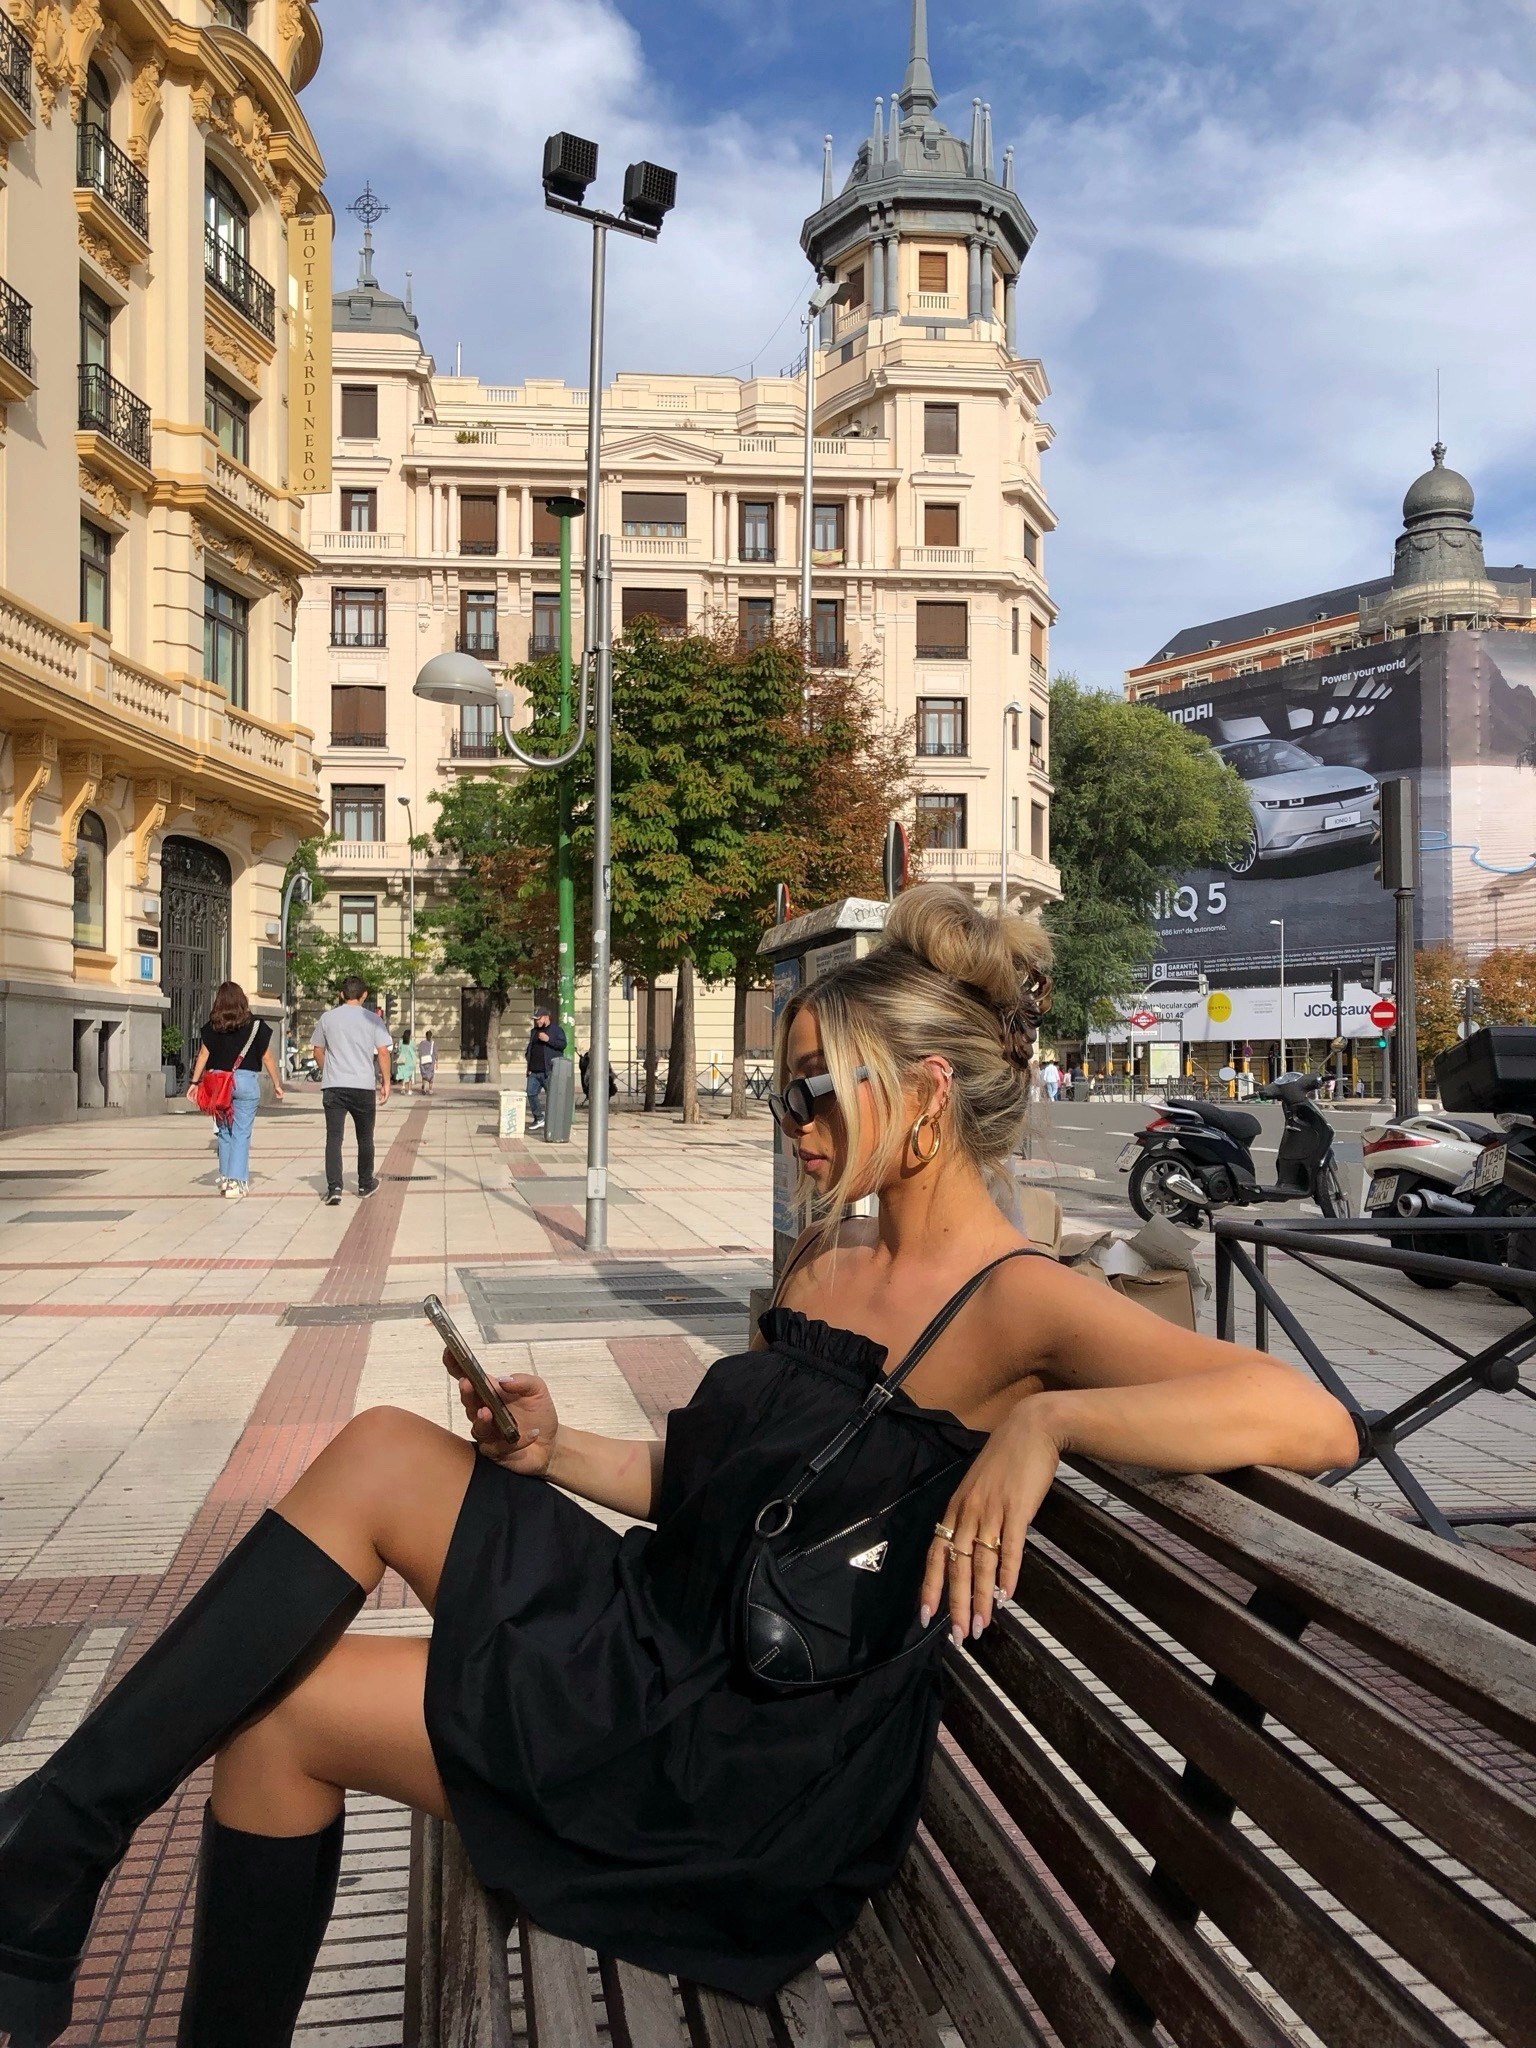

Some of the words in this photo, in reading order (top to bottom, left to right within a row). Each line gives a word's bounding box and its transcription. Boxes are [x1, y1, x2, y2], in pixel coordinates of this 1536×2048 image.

[303, 228, 316, 310] HOTEL
[303, 331, 316, 482] SARDINERO
[1321, 672, 1352, 685] Power
[1353, 667, 1376, 680] your
[1377, 658, 1406, 673] world
[1167, 703, 1213, 724] NDAI
[1141, 886, 1198, 922] NIQ
[1206, 882, 1227, 915] 5
[1193, 924, 1227, 933] autonomía.
[1154, 965, 1163, 977] 8
[1168, 963, 1198, 971] GARANTÍA
[1176, 969, 1198, 977] BATERÍA
[1175, 1011, 1184, 1019] 42
[1304, 1003, 1371, 1017] JCDecaux
